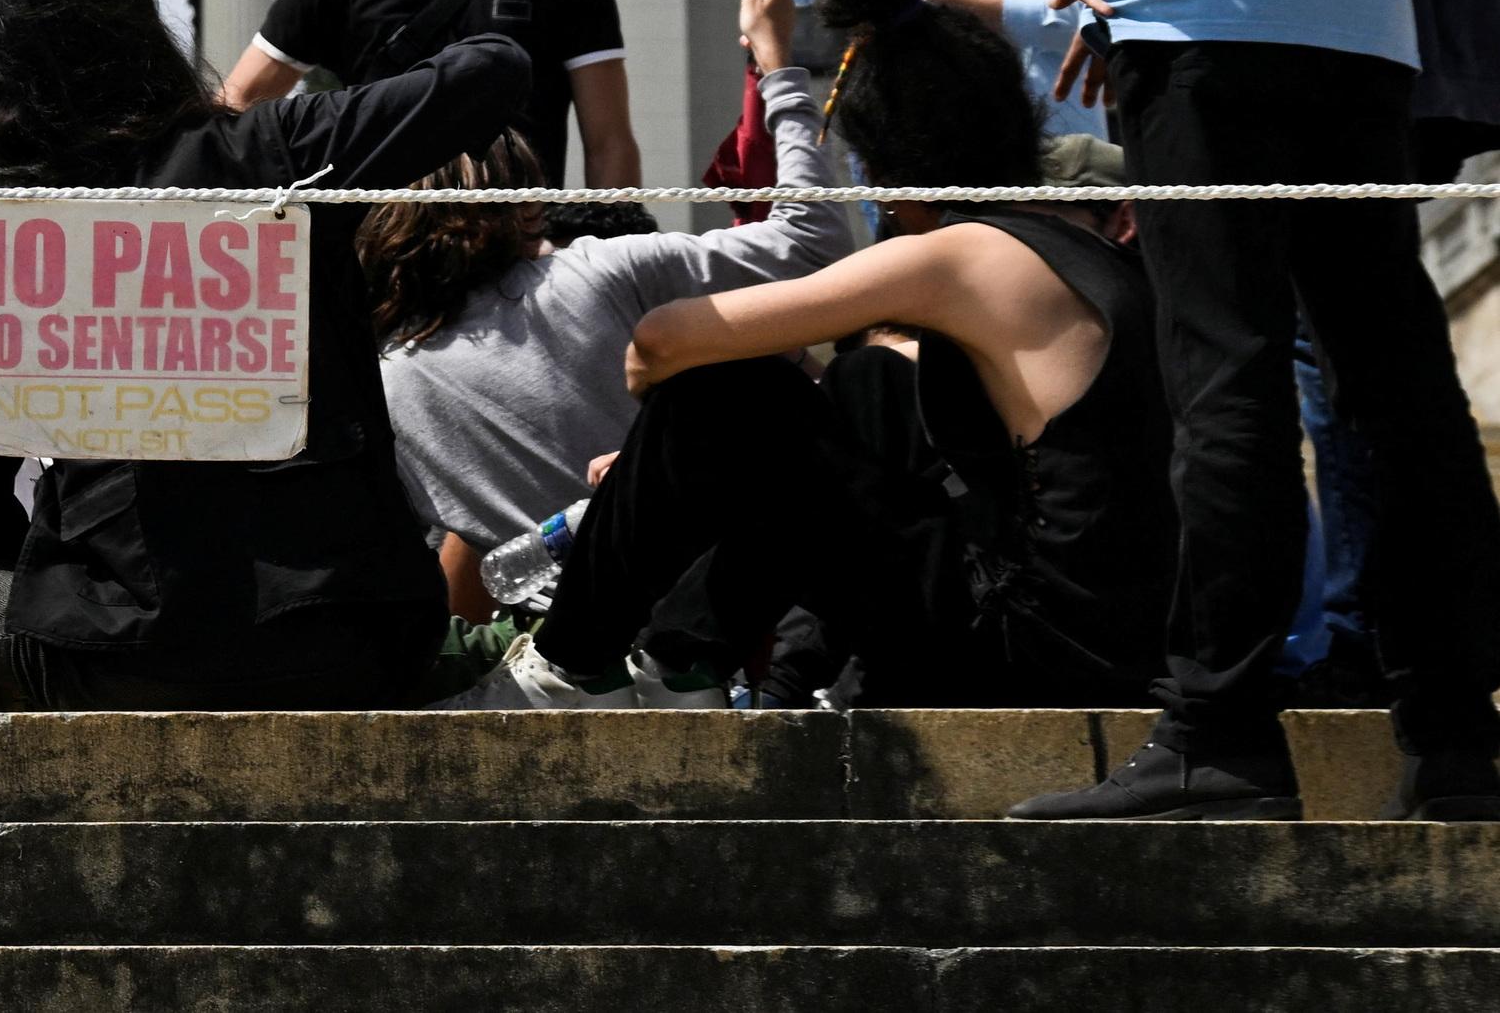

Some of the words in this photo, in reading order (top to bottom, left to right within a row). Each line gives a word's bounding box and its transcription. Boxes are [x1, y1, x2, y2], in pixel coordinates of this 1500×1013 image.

[92, 220, 298, 311] PASE
[37, 314, 297, 373] SENTARSE
[115, 385, 272, 423] PASS
[52, 429, 133, 452] NOT
[140, 430, 193, 453] SIT
